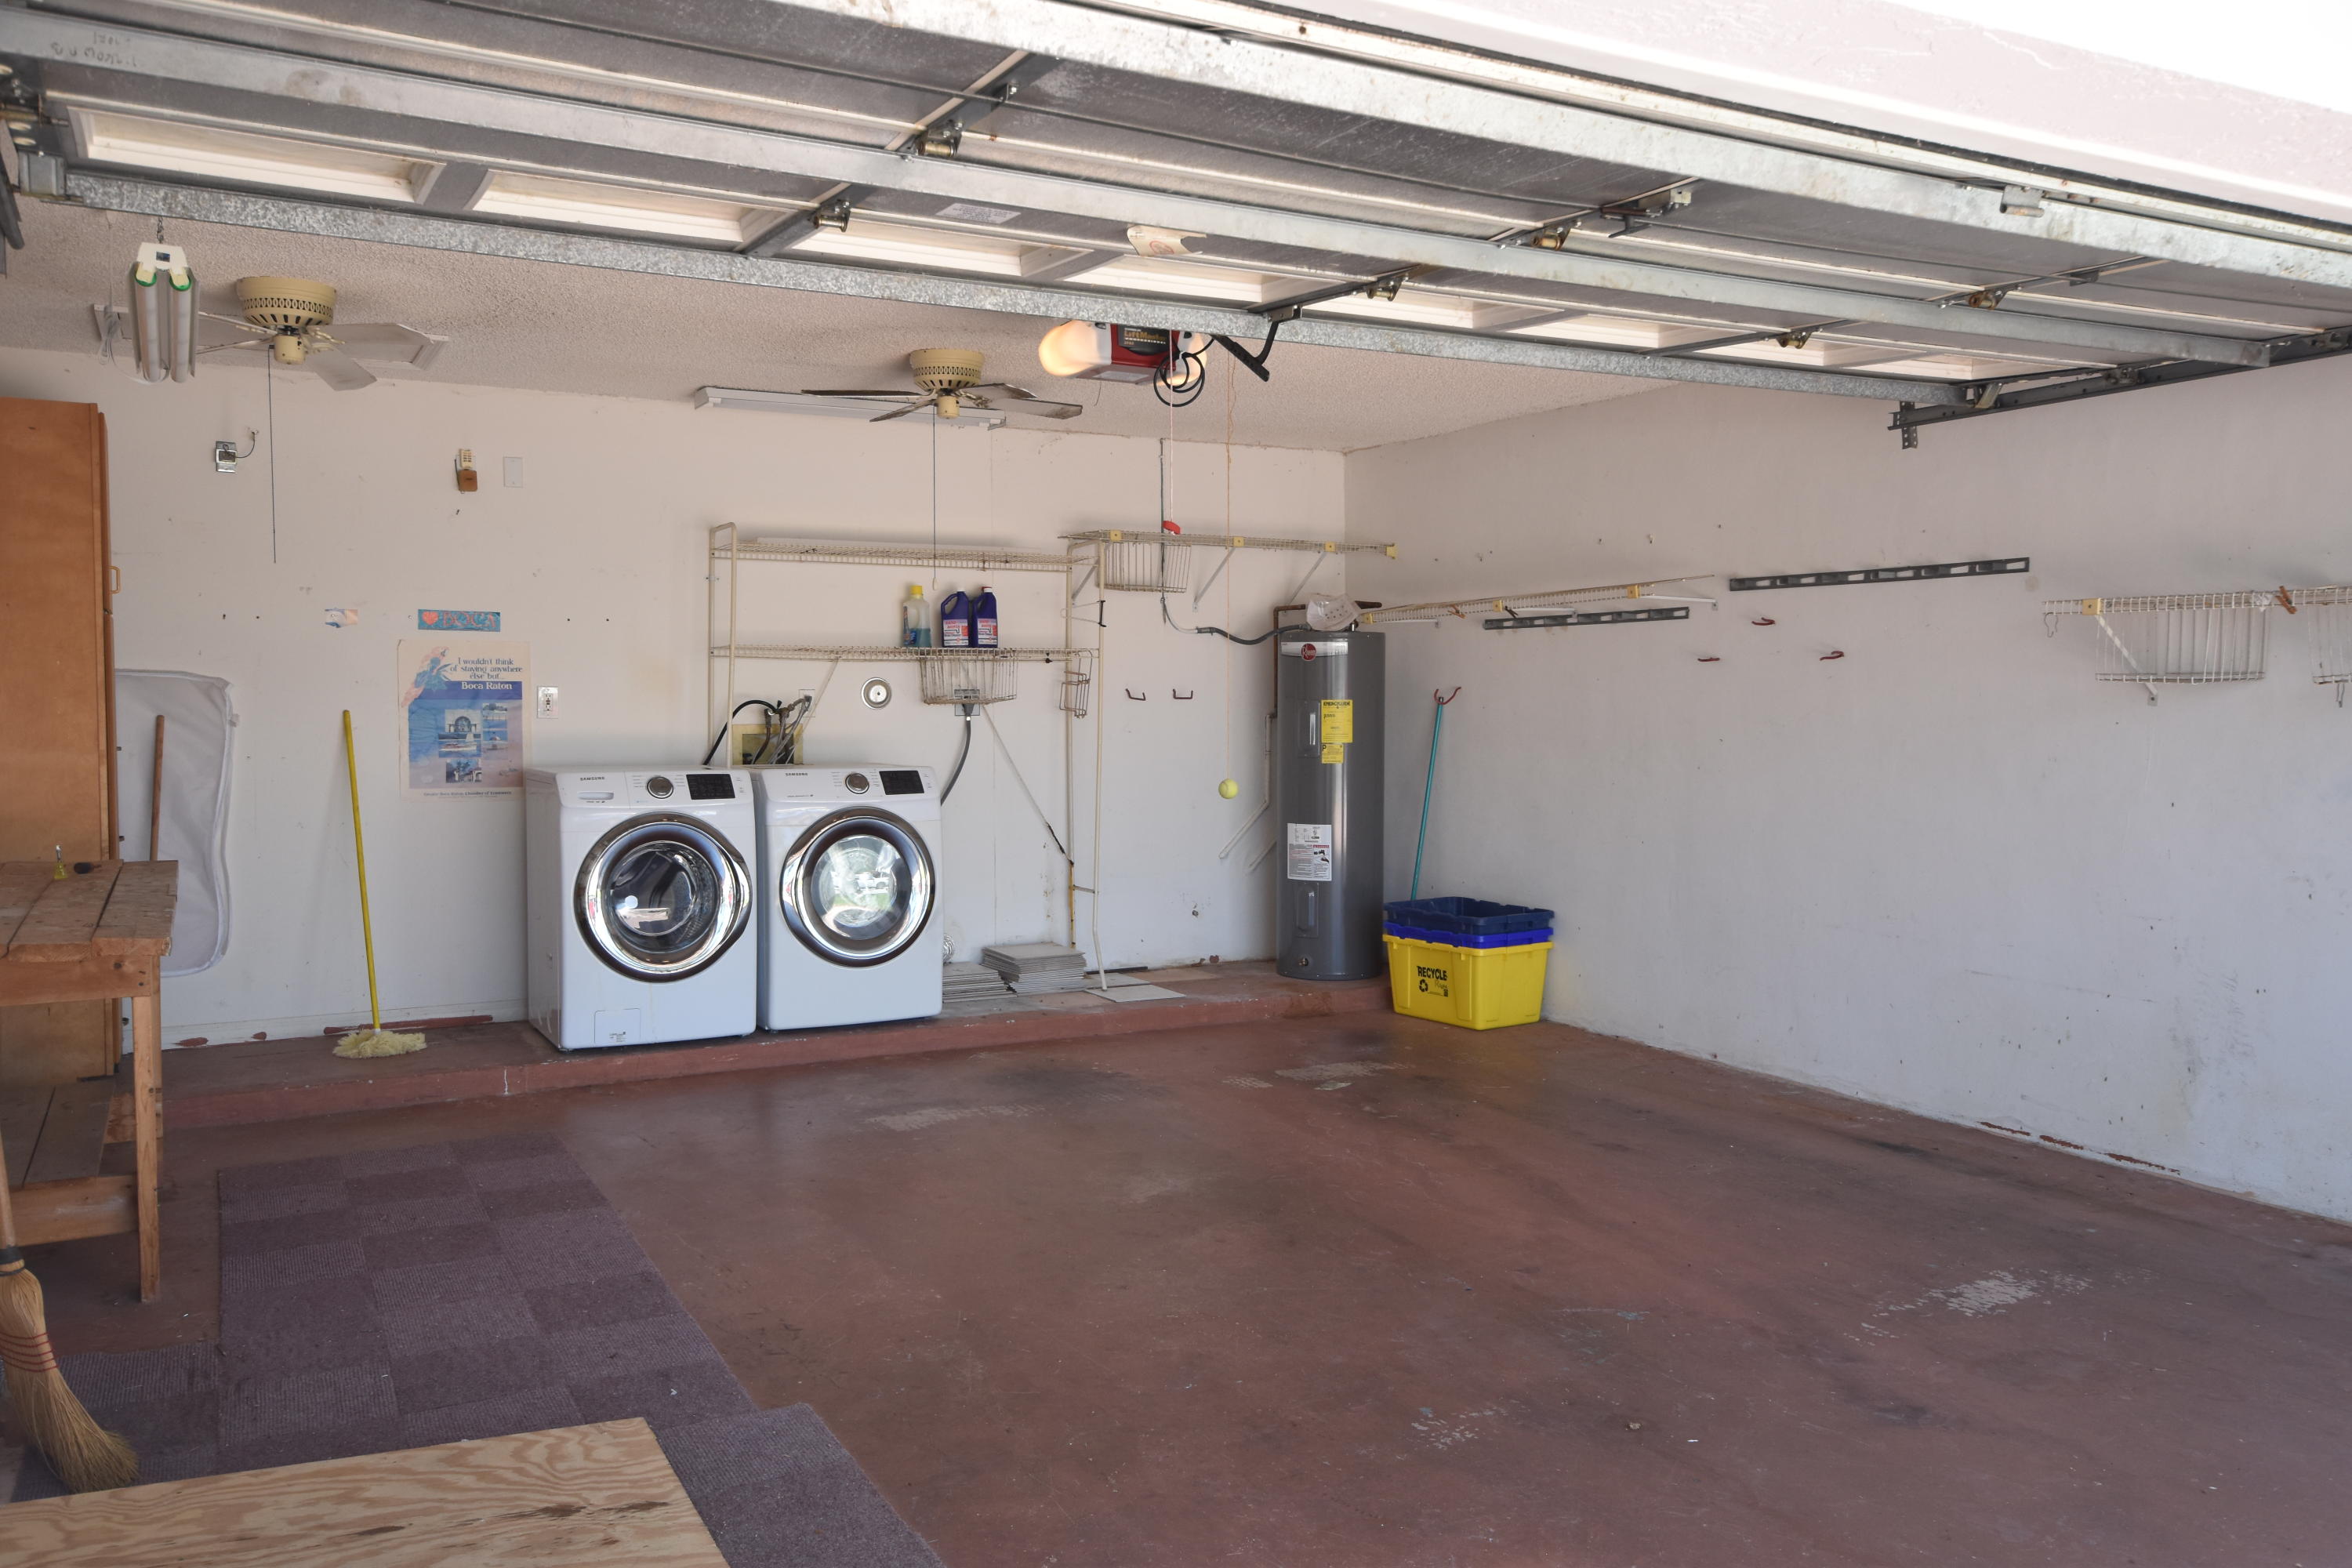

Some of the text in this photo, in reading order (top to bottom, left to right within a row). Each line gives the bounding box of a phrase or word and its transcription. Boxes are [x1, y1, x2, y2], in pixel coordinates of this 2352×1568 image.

[443, 611, 496, 628] BOCA
[461, 681, 513, 690] Boca Raton
[1417, 965, 1447, 981] RECYCLE
